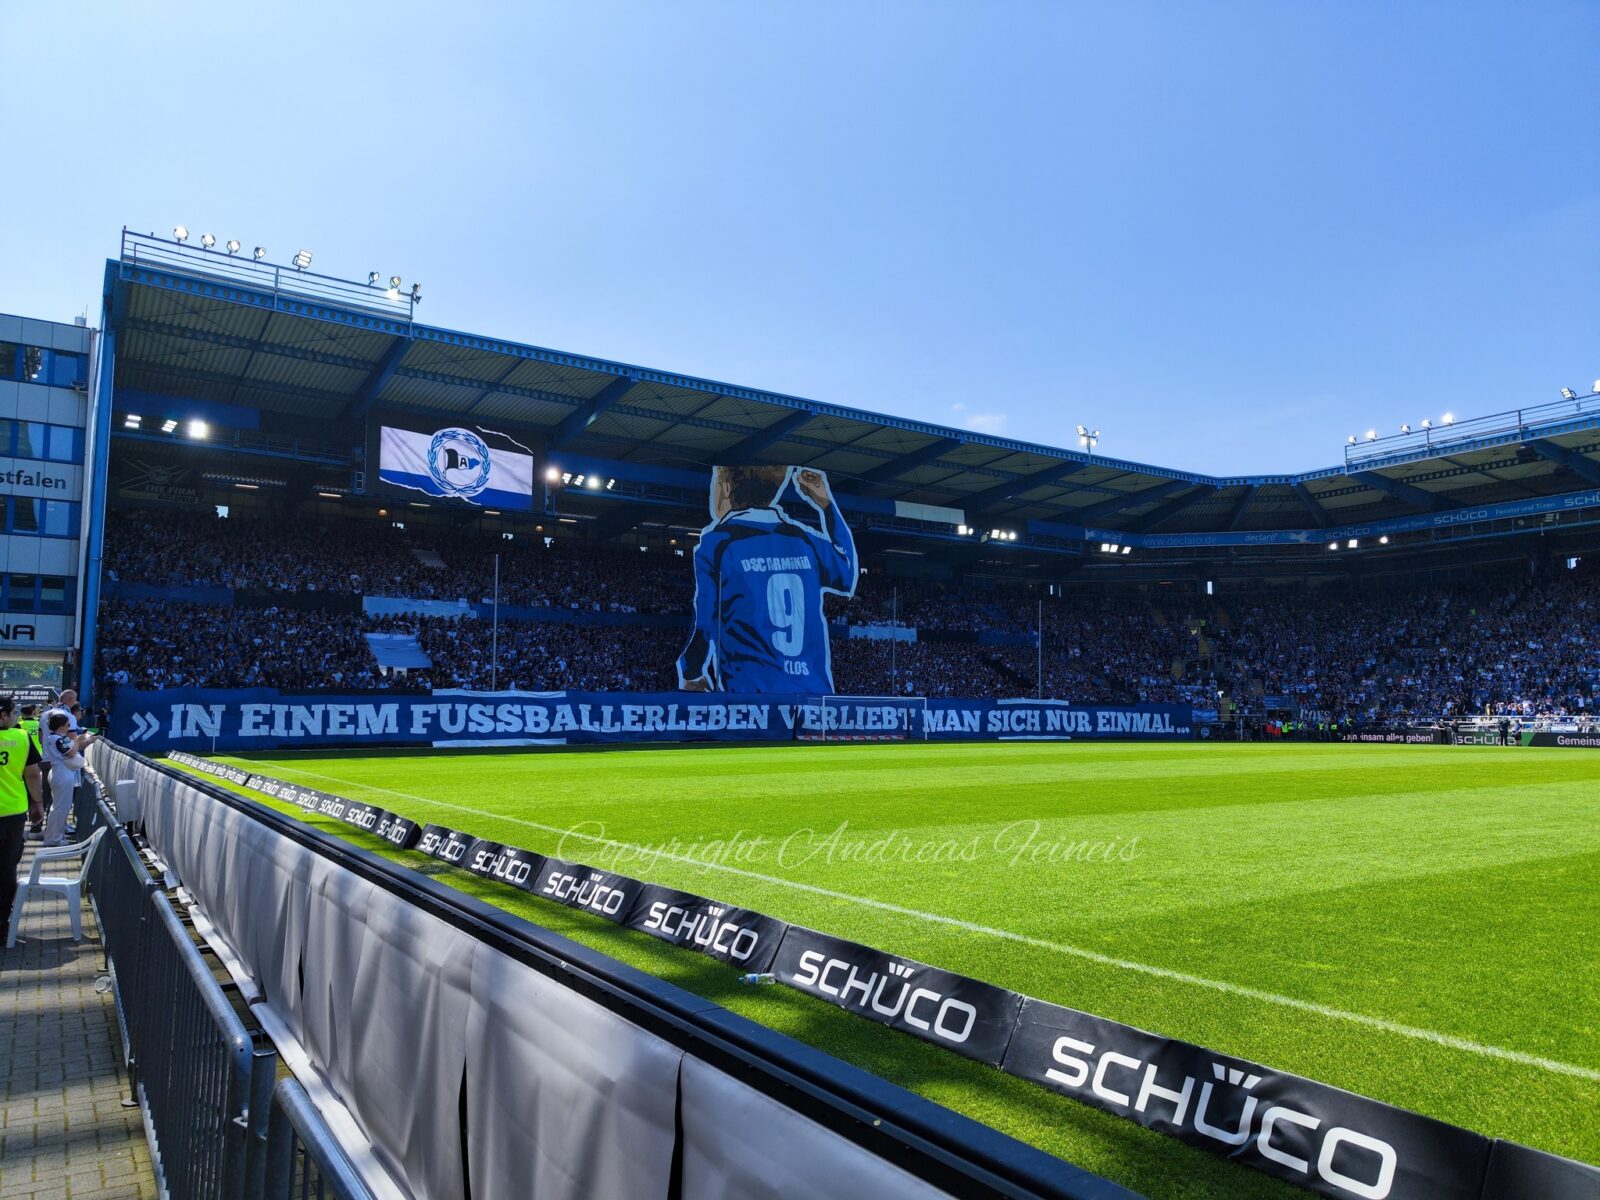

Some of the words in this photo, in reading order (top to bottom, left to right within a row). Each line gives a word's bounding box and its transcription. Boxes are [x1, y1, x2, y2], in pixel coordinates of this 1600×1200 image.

[459, 457, 469, 468] A
[1434, 510, 1488, 524] SCHÜCO
[1143, 535, 1217, 546] www.declaro.de
[1325, 527, 1371, 540] SCHÜCO
[741, 557, 766, 572] DSC
[766, 573, 805, 656] 9
[784, 659, 810, 676] KLOS
[168, 703, 226, 738] IN
[238, 703, 399, 737] EINEM
[410, 703, 769, 735] FUSSBALLERLEBEN
[778, 704, 916, 731] VERLIEBT
[922, 708, 981, 733] MAN
[987, 708, 1041, 733] SICH
[1046, 708, 1092, 733] NUR
[1406, 733, 1434, 743] geben!
[1557, 735, 1600, 746] Gemeins
[318, 797, 345, 818] SCHÜCO
[345, 806, 377, 829] SCHÜCO
[376, 818, 407, 844] SCHÜCO
[419, 832, 467, 861] SCHÜCO
[471, 849, 531, 884] SCHÜCO
[543, 872, 625, 916] SCHÜCO
[644, 901, 759, 960] SCHÜCO
[794, 949, 977, 1044] SCHÜCO
[1044, 1035, 1398, 1200] SCHÜCO
